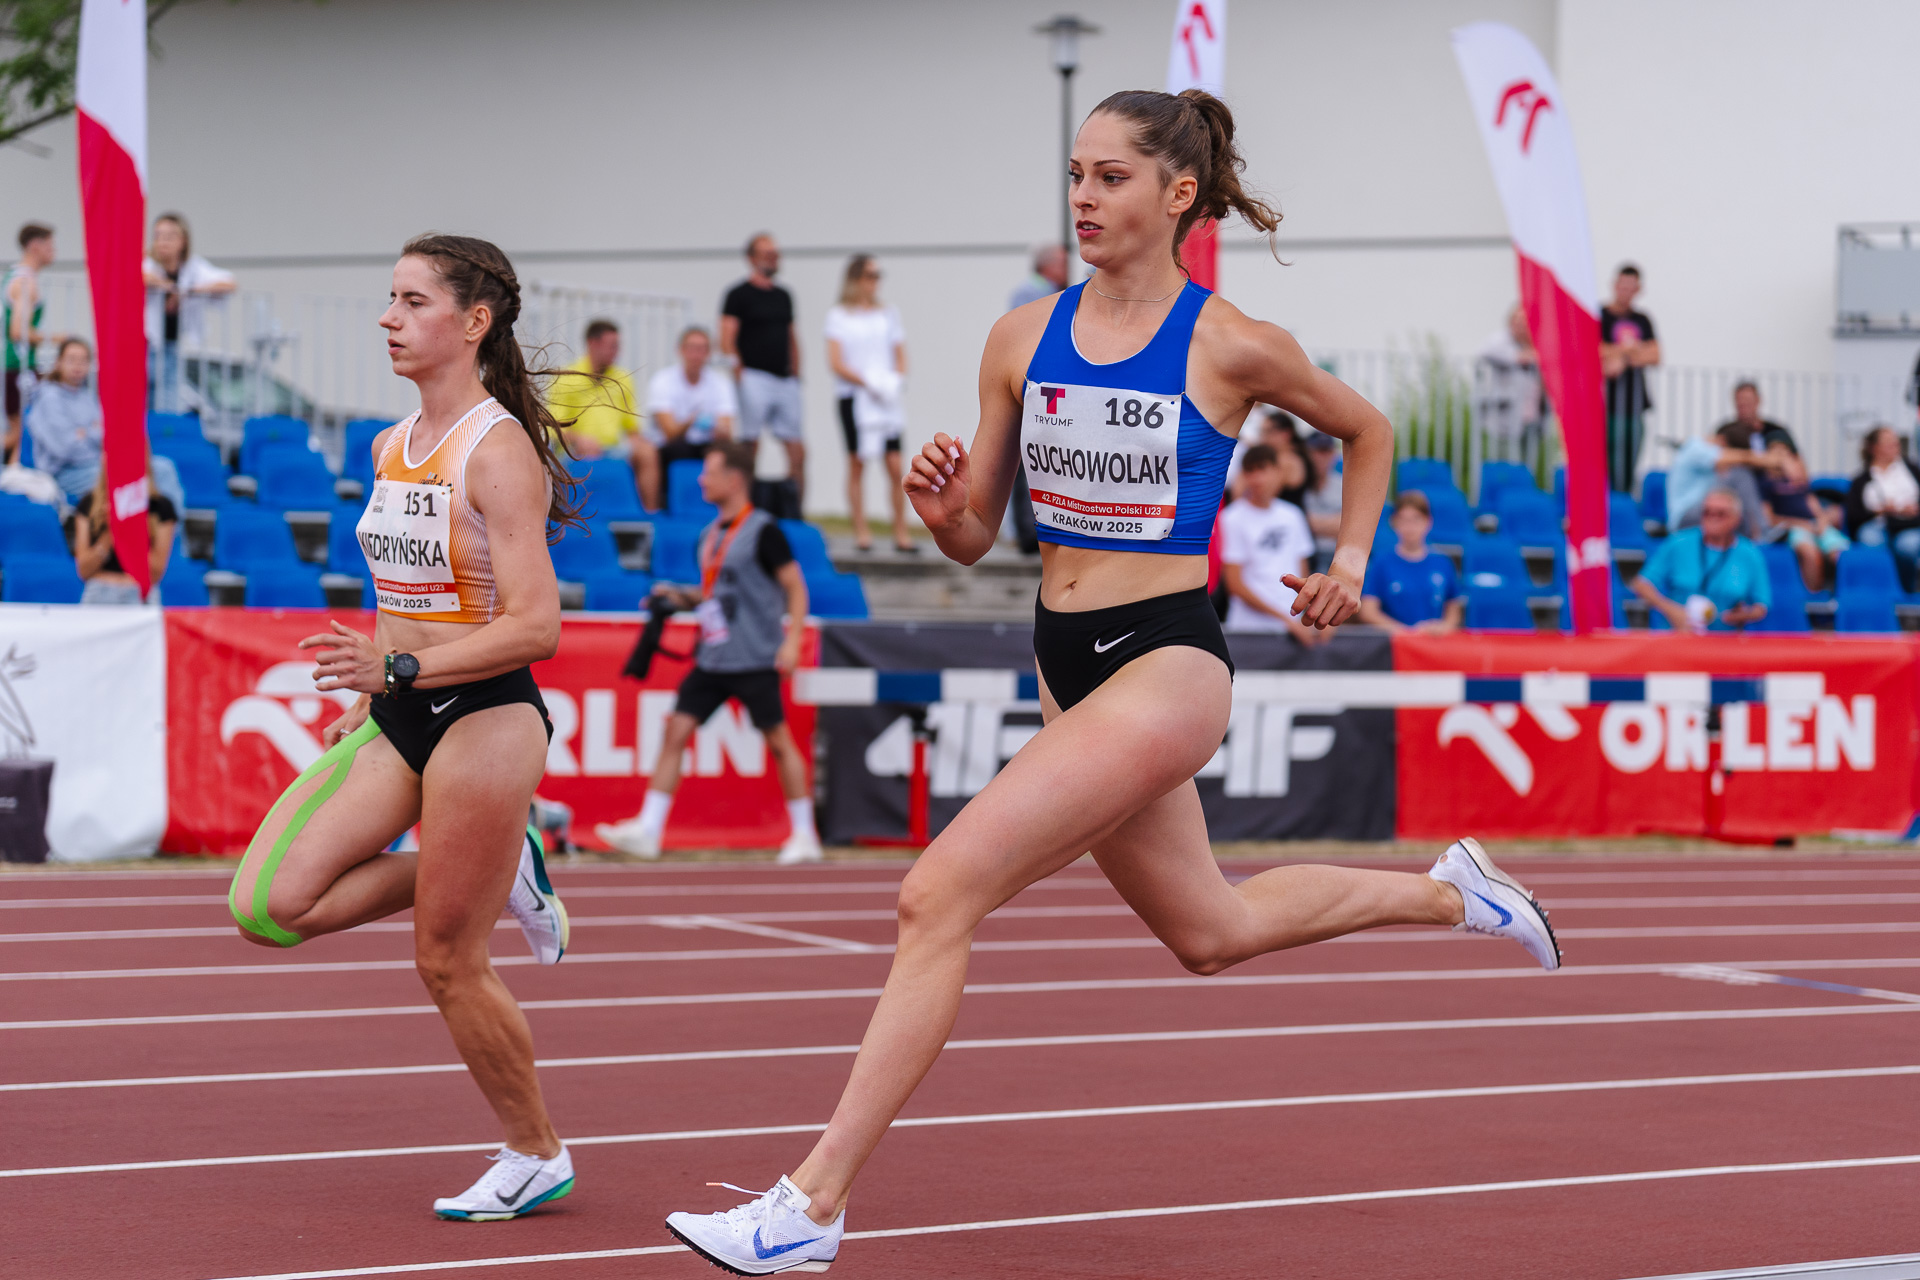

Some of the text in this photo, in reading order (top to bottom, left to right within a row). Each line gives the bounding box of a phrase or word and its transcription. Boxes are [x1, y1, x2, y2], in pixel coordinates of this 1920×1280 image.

[1034, 414, 1074, 427] TRYUMF
[1105, 397, 1164, 429] 186
[1026, 442, 1171, 485] SUCHOWOLAK
[404, 491, 437, 517] 151
[1041, 493, 1162, 516] 42. PZLA Mistrzostwa Polski U23
[1052, 512, 1143, 534] KRAKÓW 2025
[406, 583, 428, 593] Polski
[429, 583, 445, 592] U23
[403, 598, 432, 609] 2025
[1599, 694, 1877, 773] ORLEN
